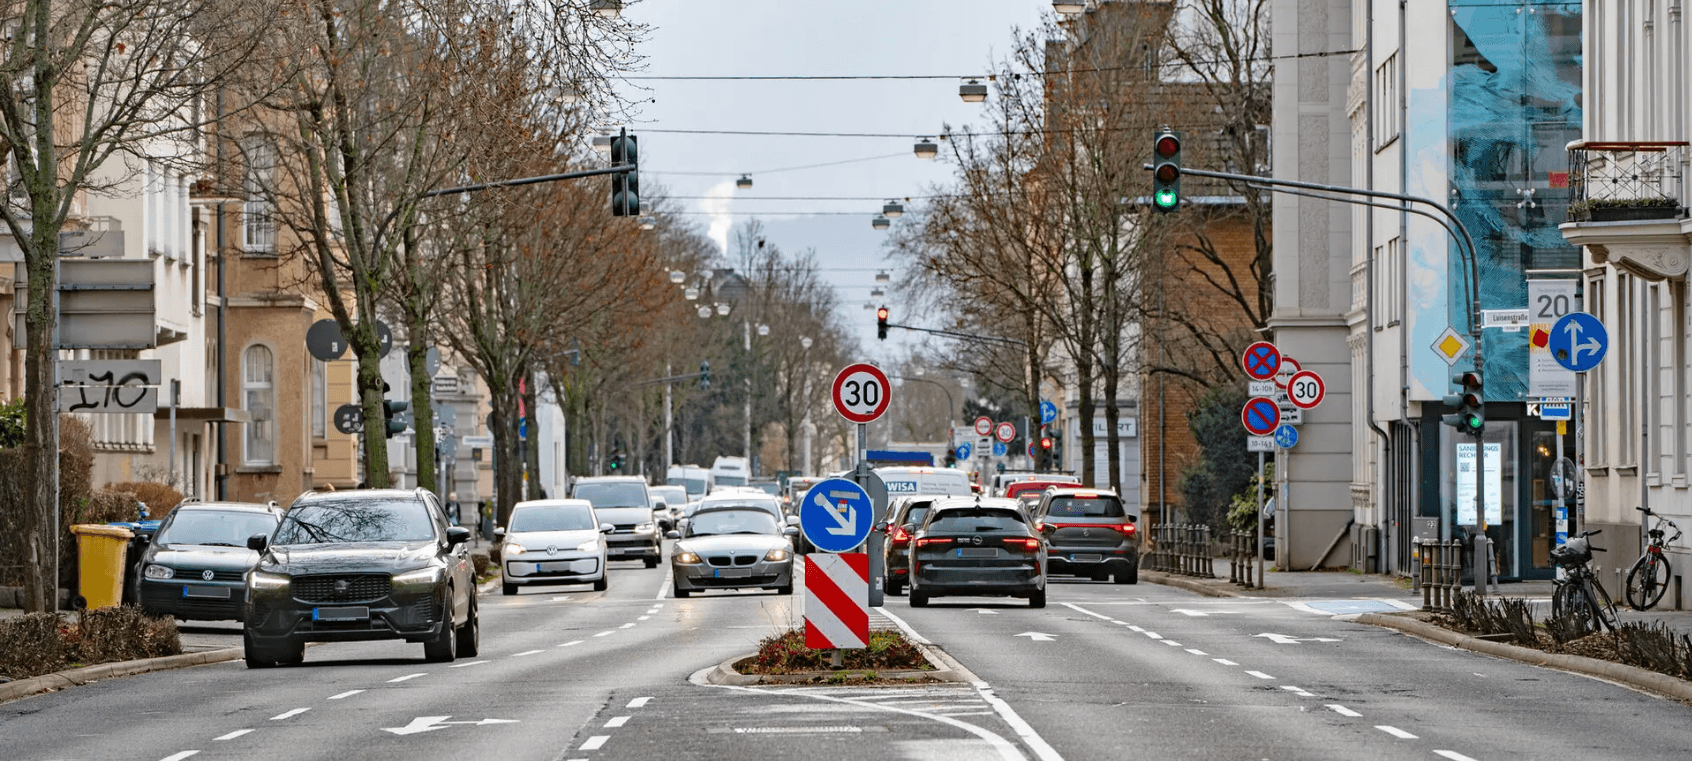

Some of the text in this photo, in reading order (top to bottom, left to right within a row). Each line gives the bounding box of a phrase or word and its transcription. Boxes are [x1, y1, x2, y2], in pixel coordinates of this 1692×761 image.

[1537, 294, 1569, 318] 20
[845, 380, 878, 407] 30
[1296, 382, 1317, 399] 30
[887, 482, 915, 492] WISA
